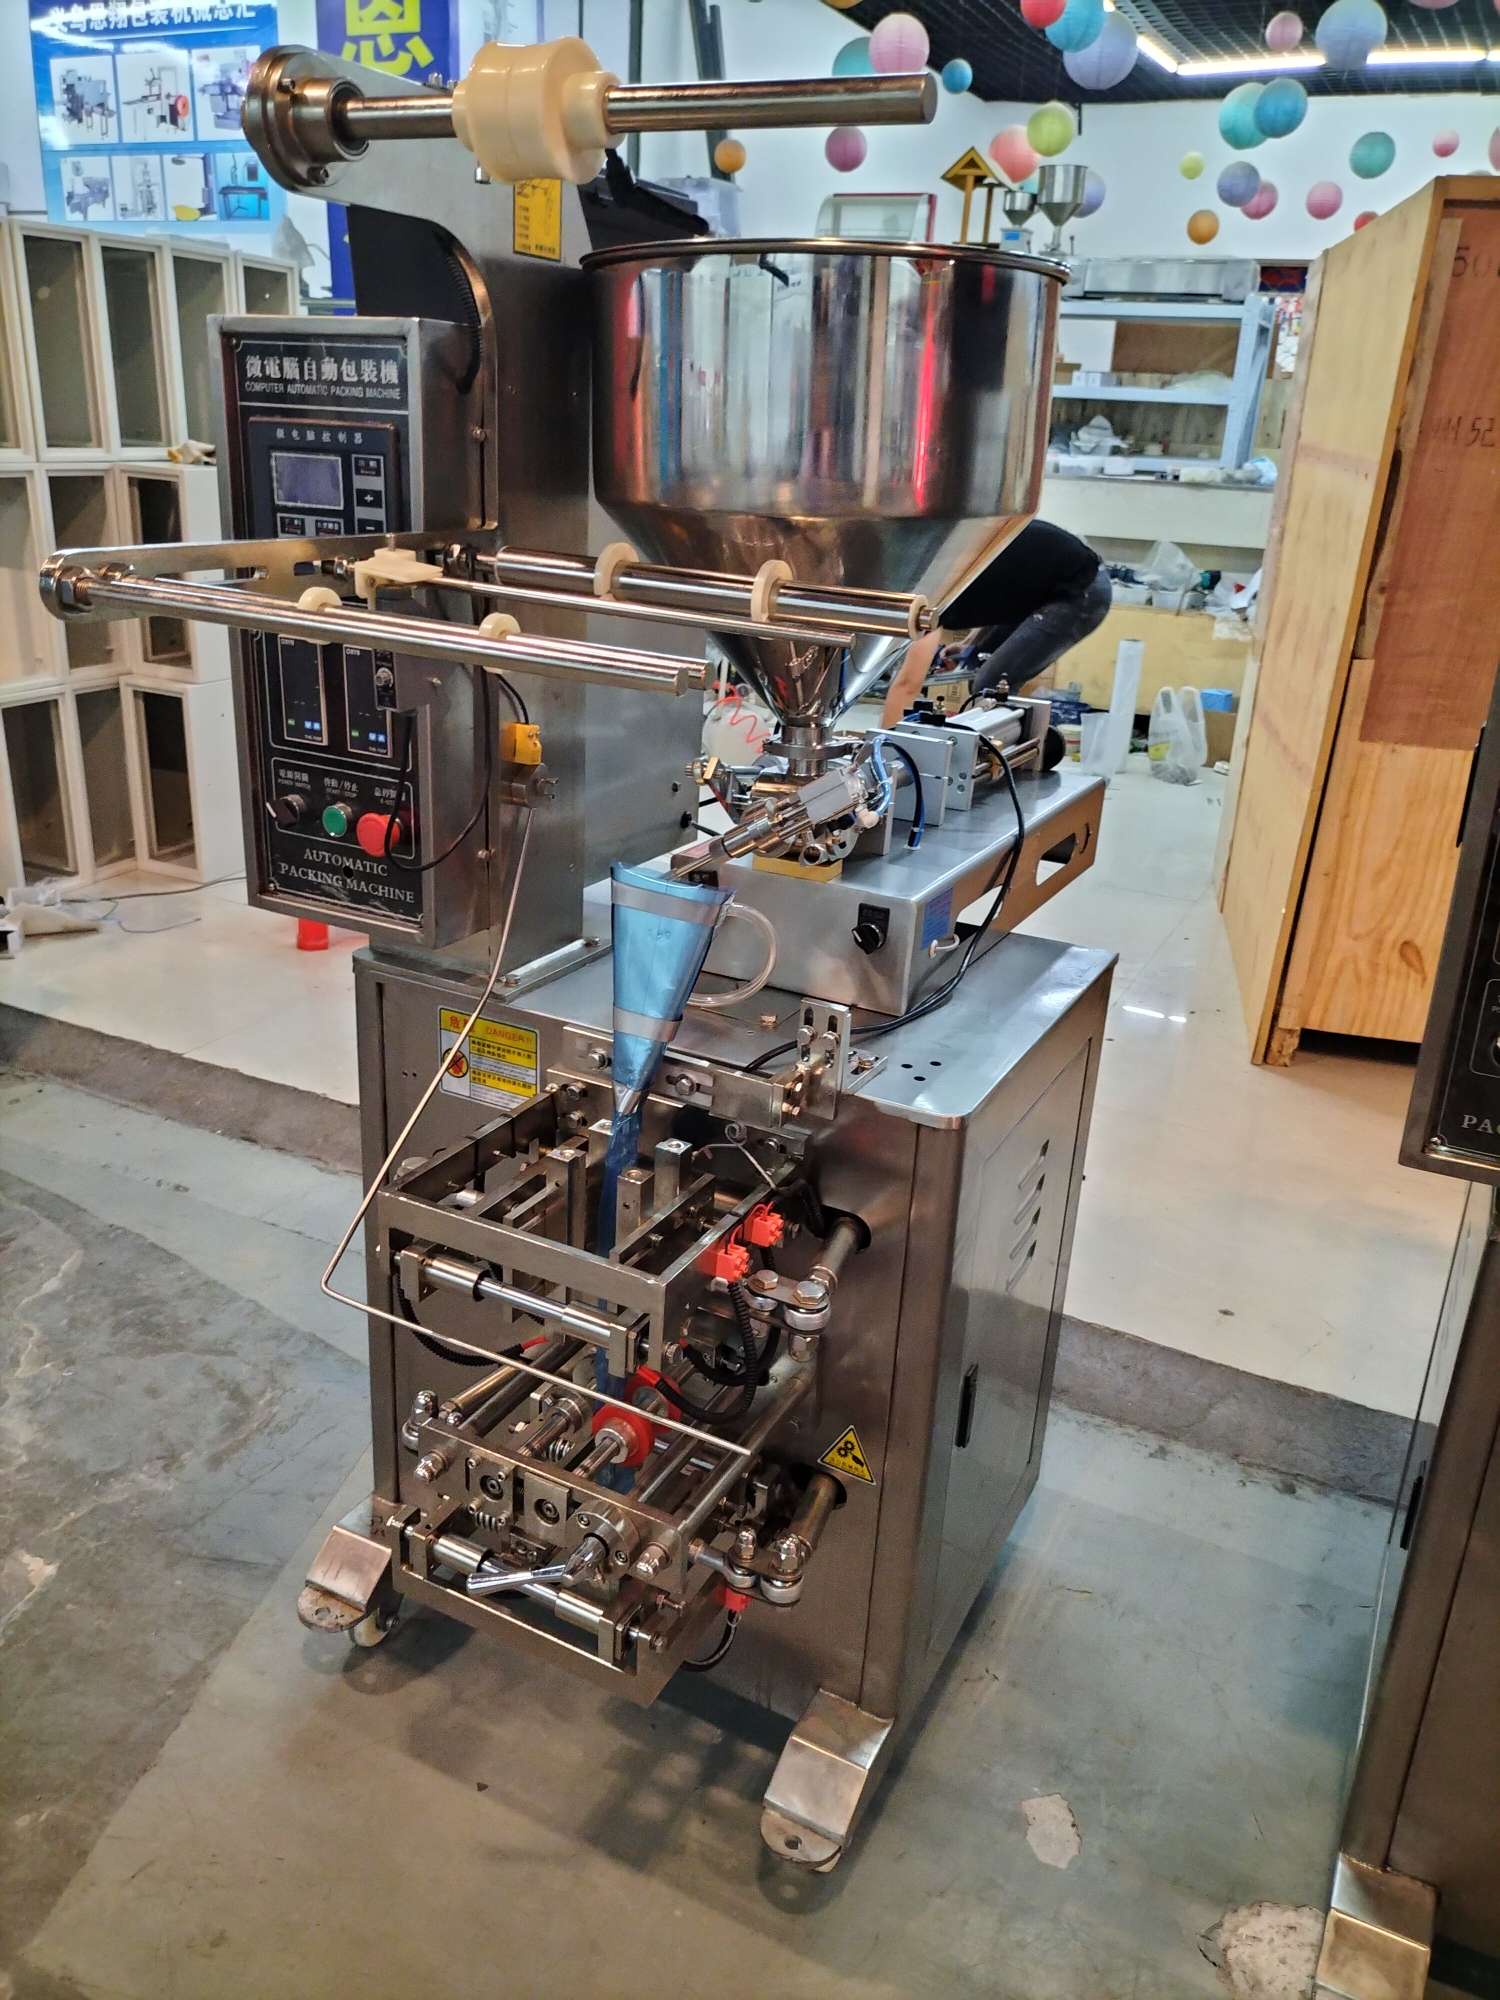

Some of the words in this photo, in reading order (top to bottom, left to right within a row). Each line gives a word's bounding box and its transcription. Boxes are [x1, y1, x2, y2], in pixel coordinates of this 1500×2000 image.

[244, 381, 285, 393] COMPUTER
[287, 383, 329, 396] AUTOMATIC
[330, 385, 364, 398] PACKING
[365, 387, 401, 400] MACHINE
[303, 848, 388, 877] AUTOMATIC
[278, 862, 343, 887] PACKING
[345, 877, 415, 904] MACHINE
